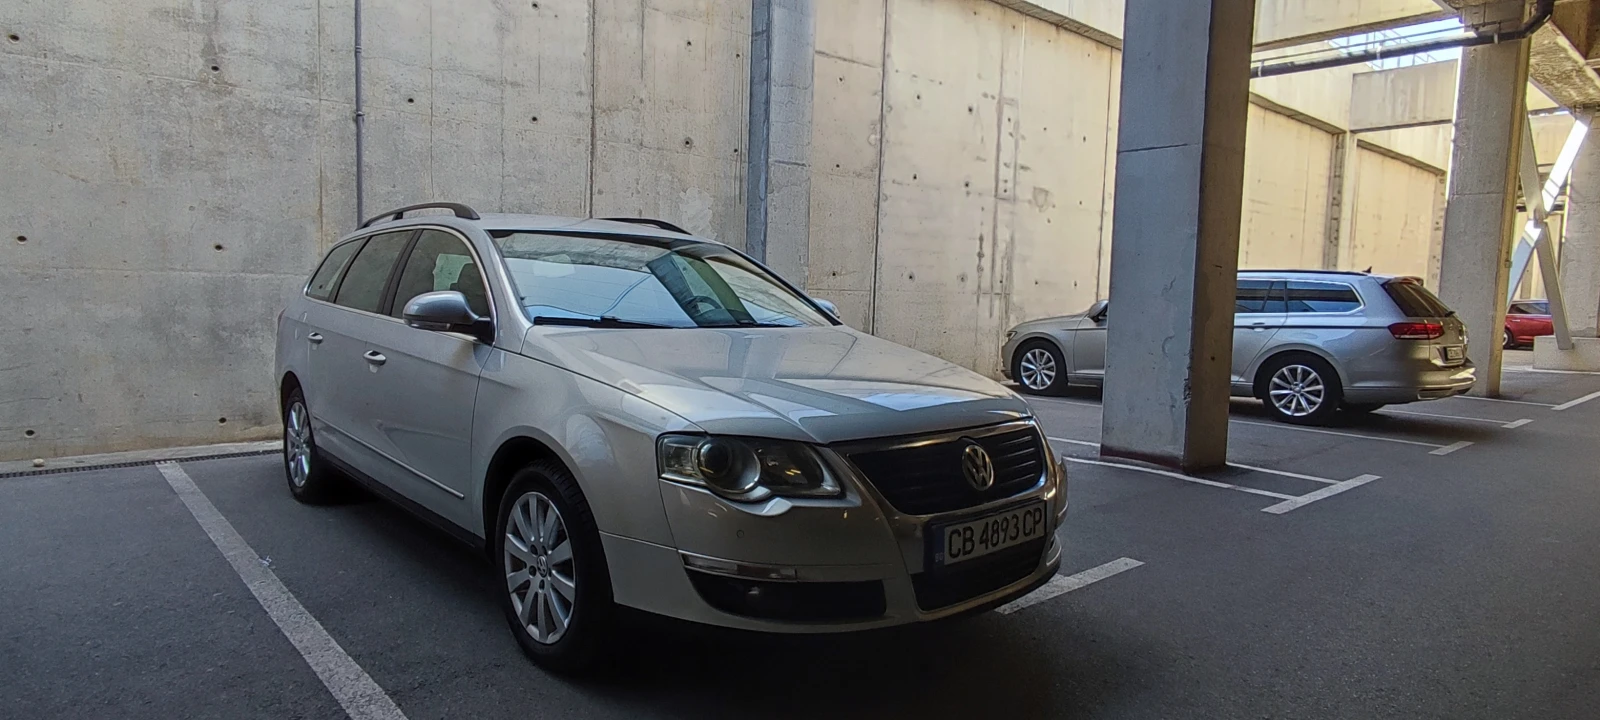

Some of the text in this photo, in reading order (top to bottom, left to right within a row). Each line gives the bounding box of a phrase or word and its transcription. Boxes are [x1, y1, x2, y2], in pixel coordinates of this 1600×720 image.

[948, 507, 1042, 558] CB 4893 CP
